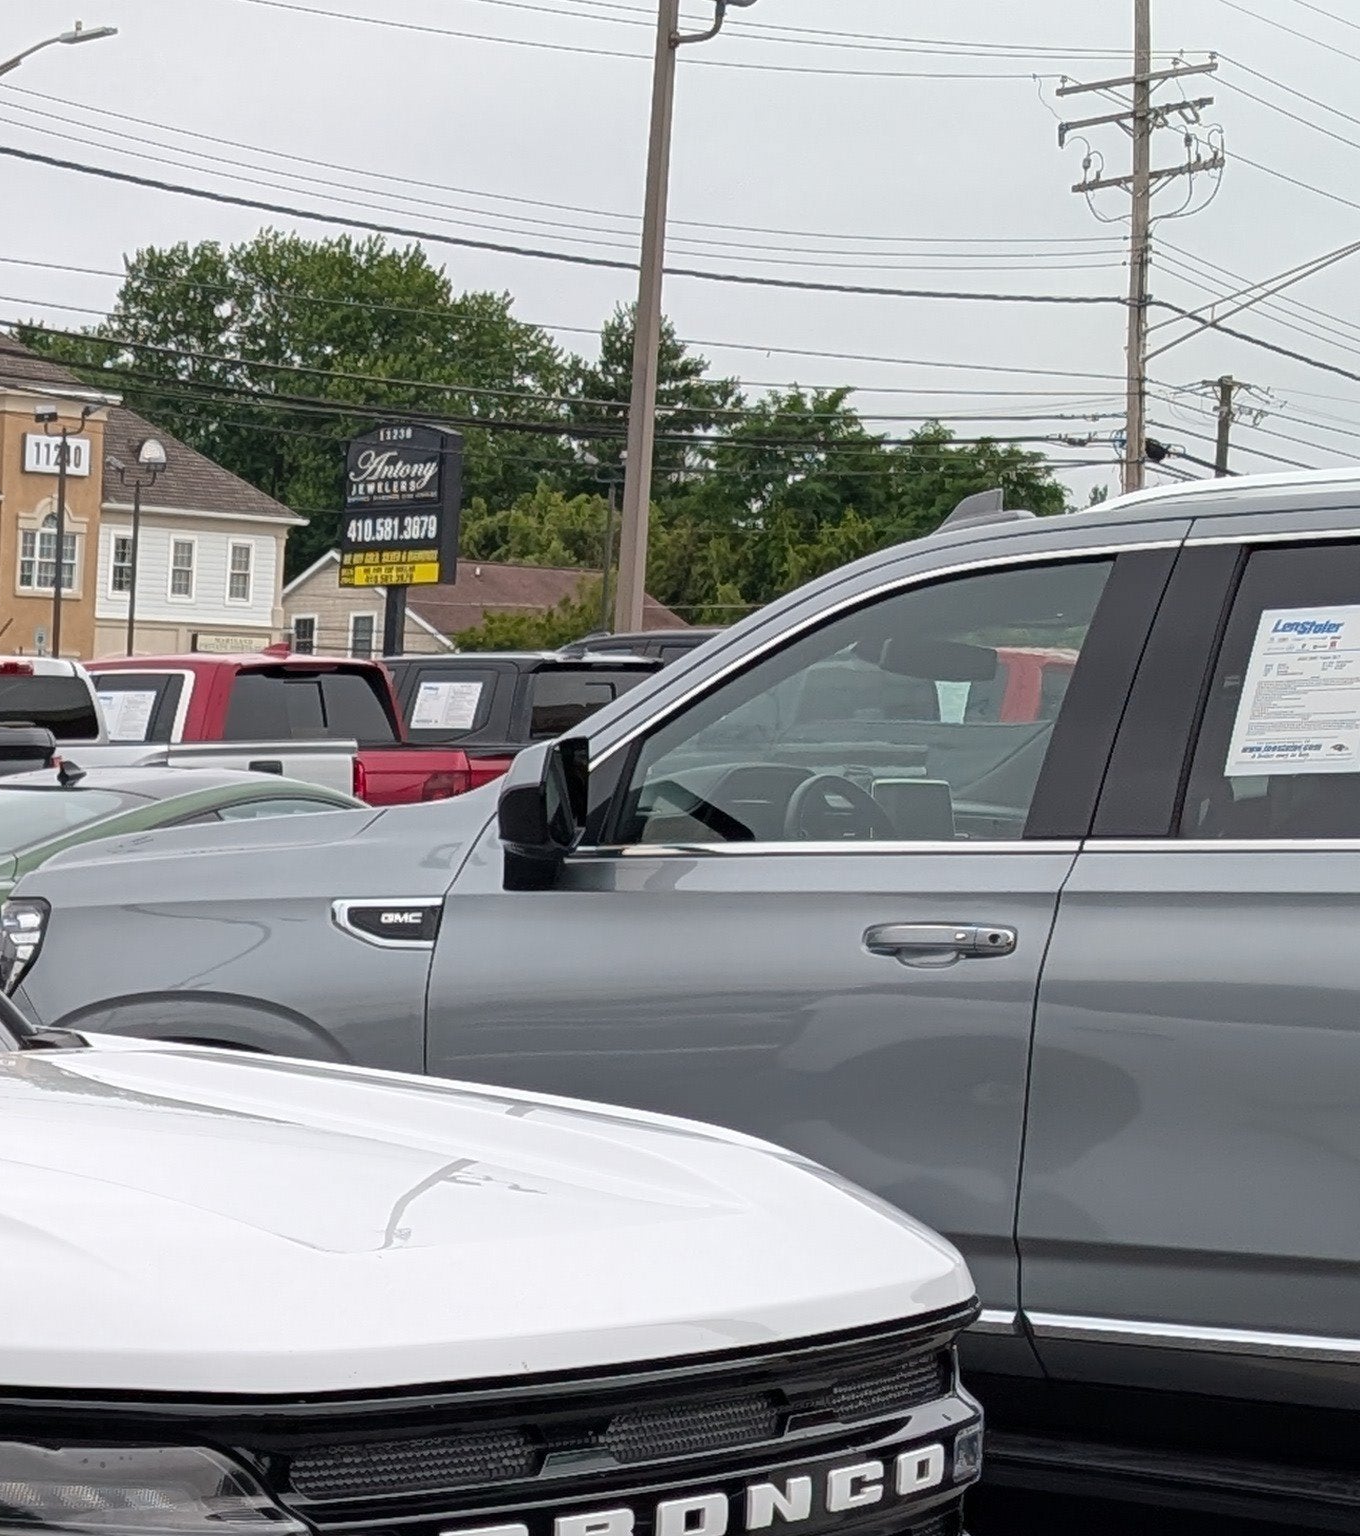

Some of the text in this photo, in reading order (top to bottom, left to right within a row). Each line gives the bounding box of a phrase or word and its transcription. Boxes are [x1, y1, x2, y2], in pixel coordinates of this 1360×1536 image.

[349, 450, 438, 490] Antony
[351, 480, 417, 496] JEWELERS
[381, 912, 422, 924] GMC
